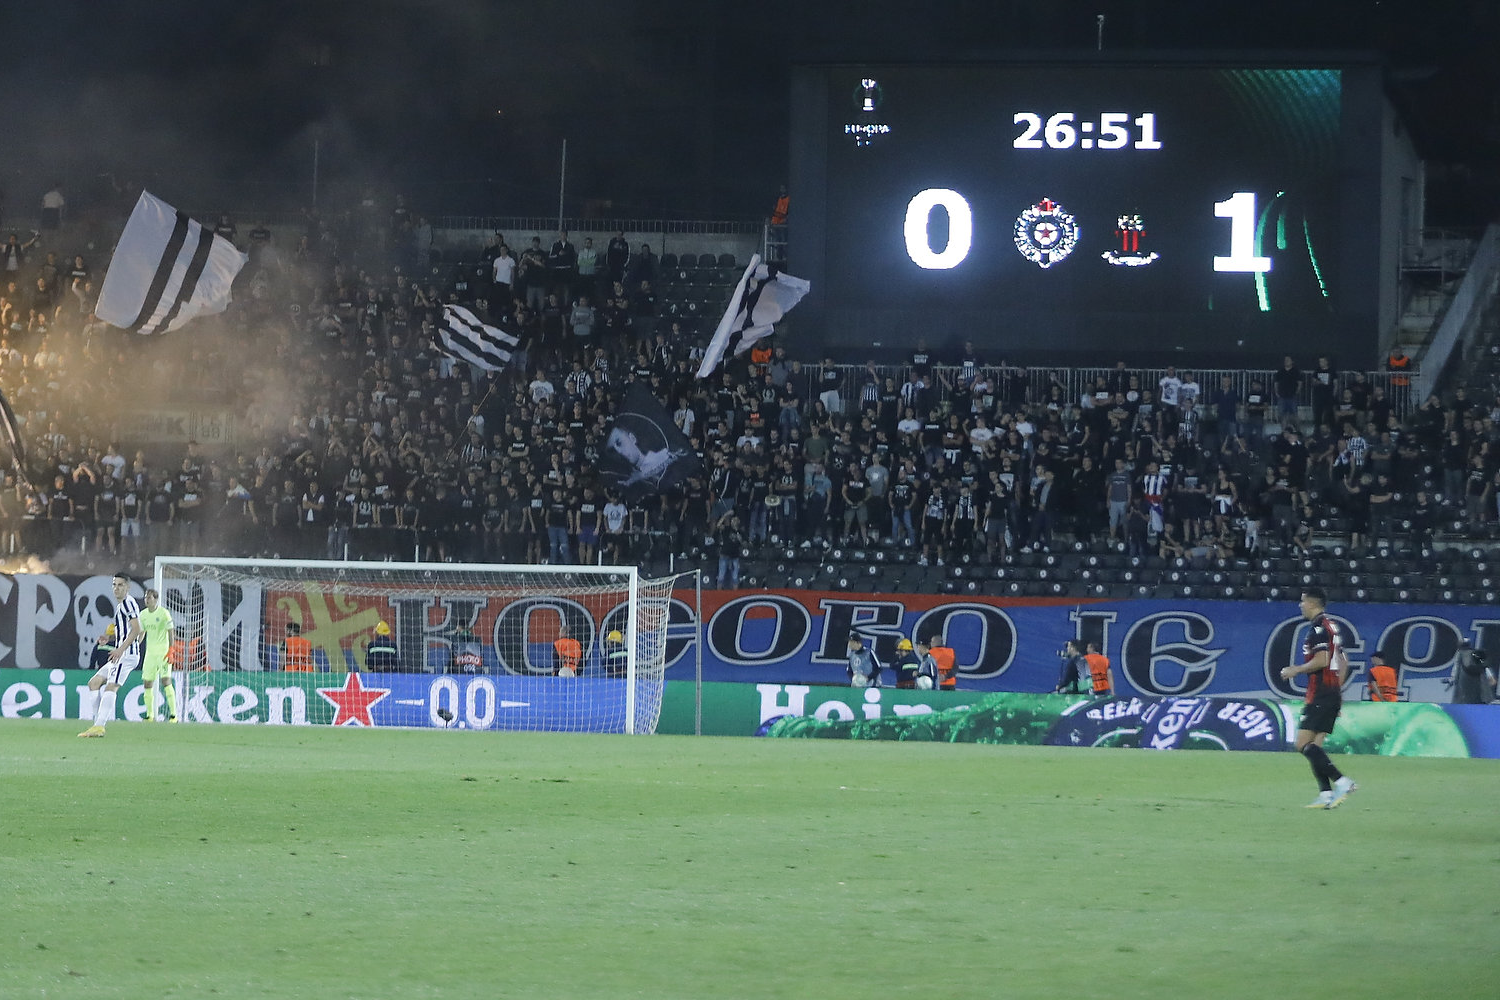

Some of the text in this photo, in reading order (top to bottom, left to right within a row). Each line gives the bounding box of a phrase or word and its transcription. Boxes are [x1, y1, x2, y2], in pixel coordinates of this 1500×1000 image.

[1013, 112, 1162, 149] 26:51
[904, 188, 972, 270] 0
[1213, 193, 1271, 272] 1
[456, 654, 480, 665] PHOTO
